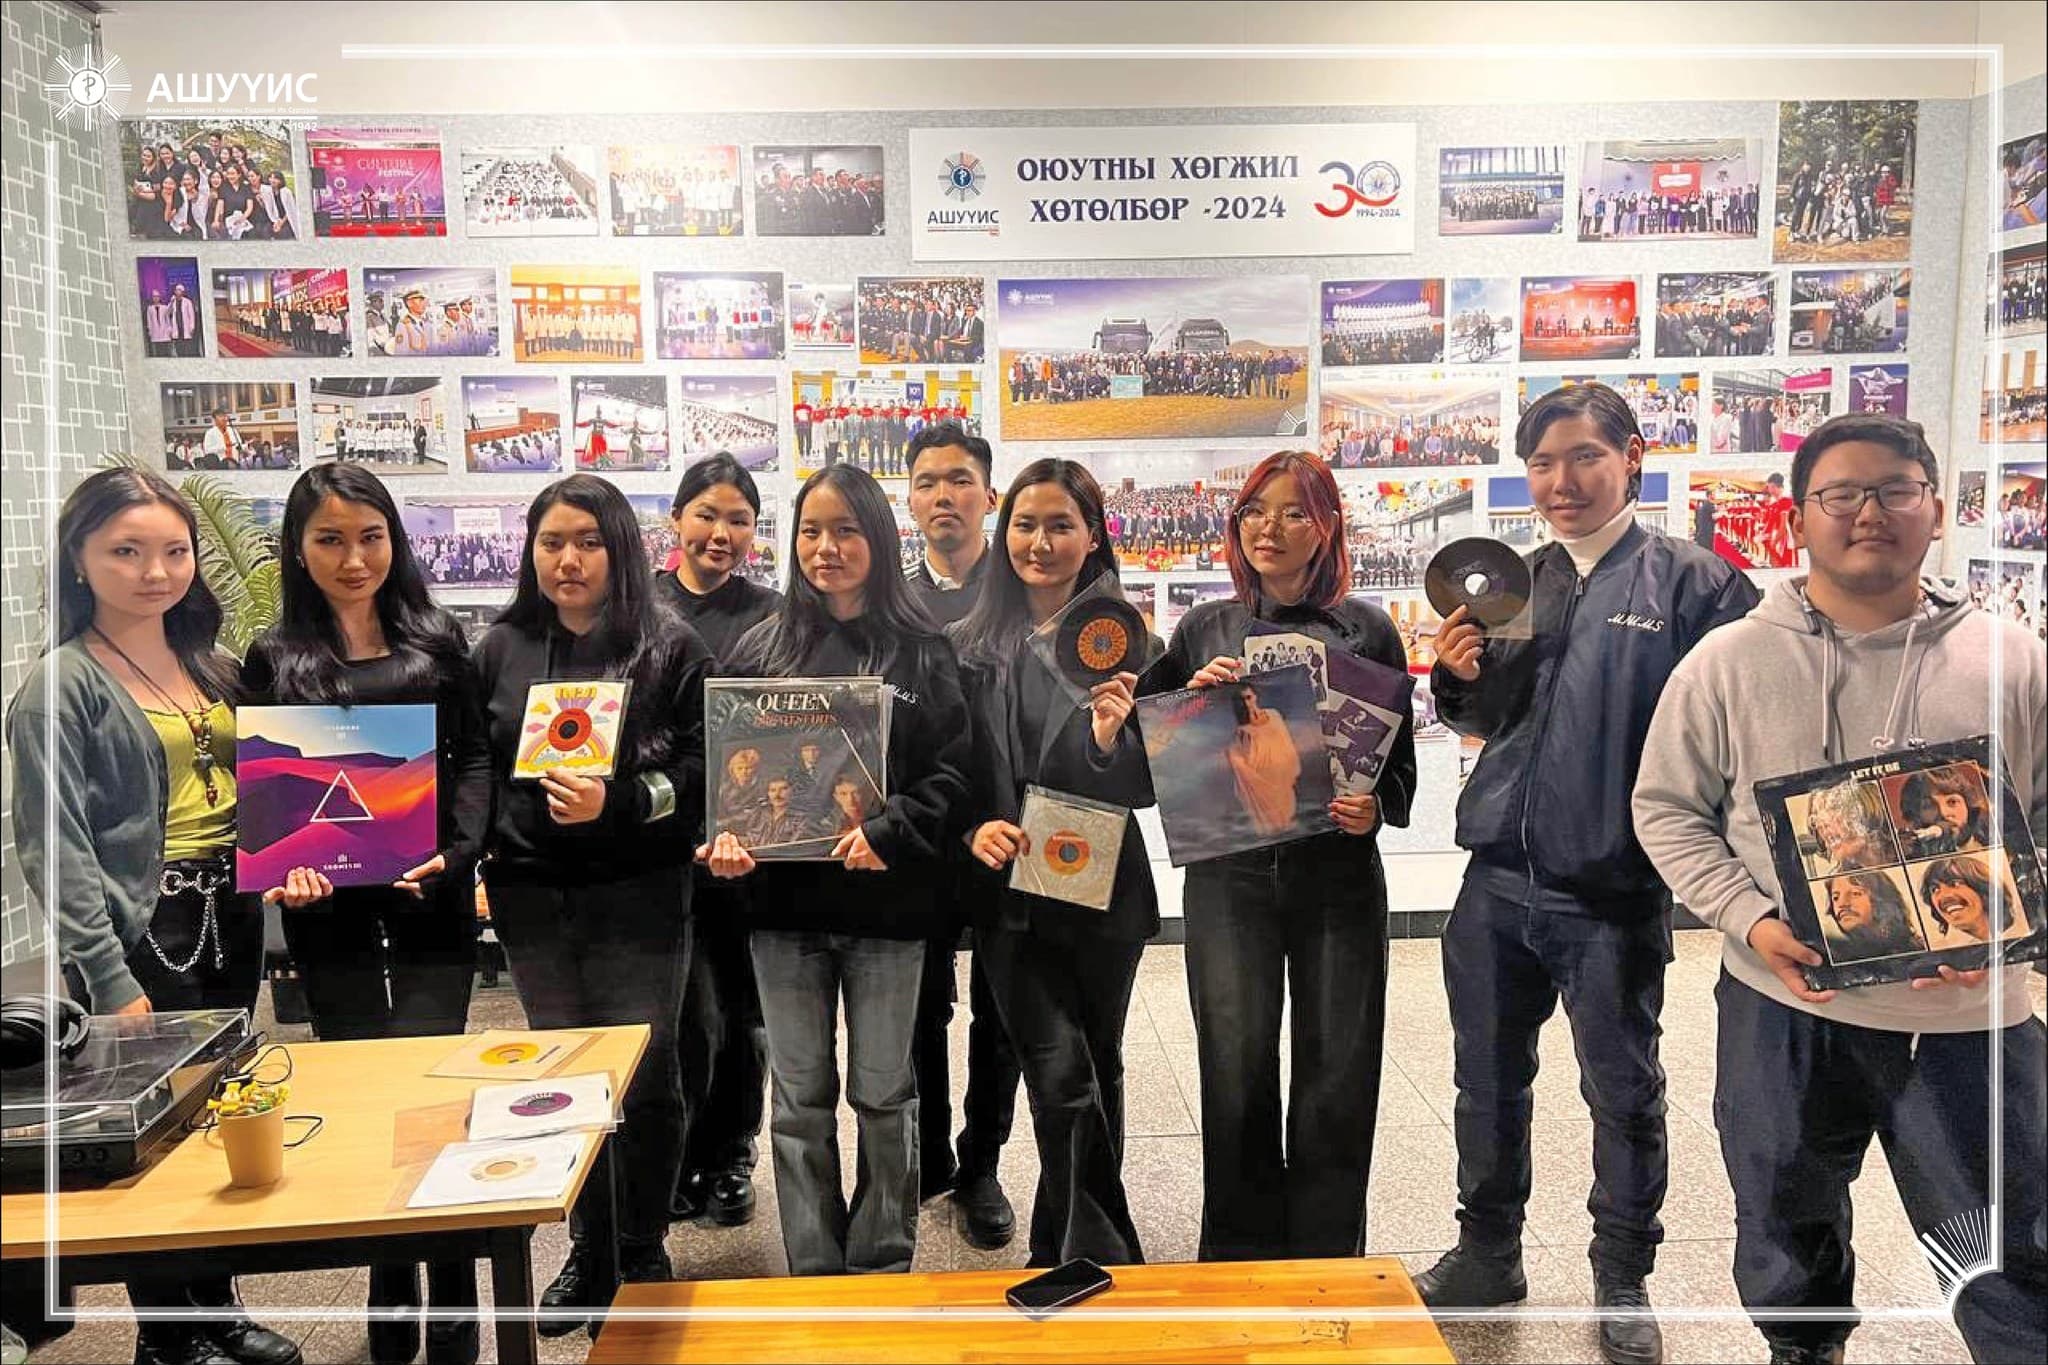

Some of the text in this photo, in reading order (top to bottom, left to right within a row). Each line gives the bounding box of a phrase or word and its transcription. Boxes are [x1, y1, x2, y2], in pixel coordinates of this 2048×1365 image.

[1017, 155, 1299, 181] ОЮУТНЫ ХӨГЖИЛ
[1029, 197, 1190, 222] ХӨТӨЛБӨР
[1356, 208, 1401, 218] 1994-2024
[756, 692, 833, 715] QUEEN
[1850, 767, 1871, 780] LET
[1871, 765, 1884, 775] IT
